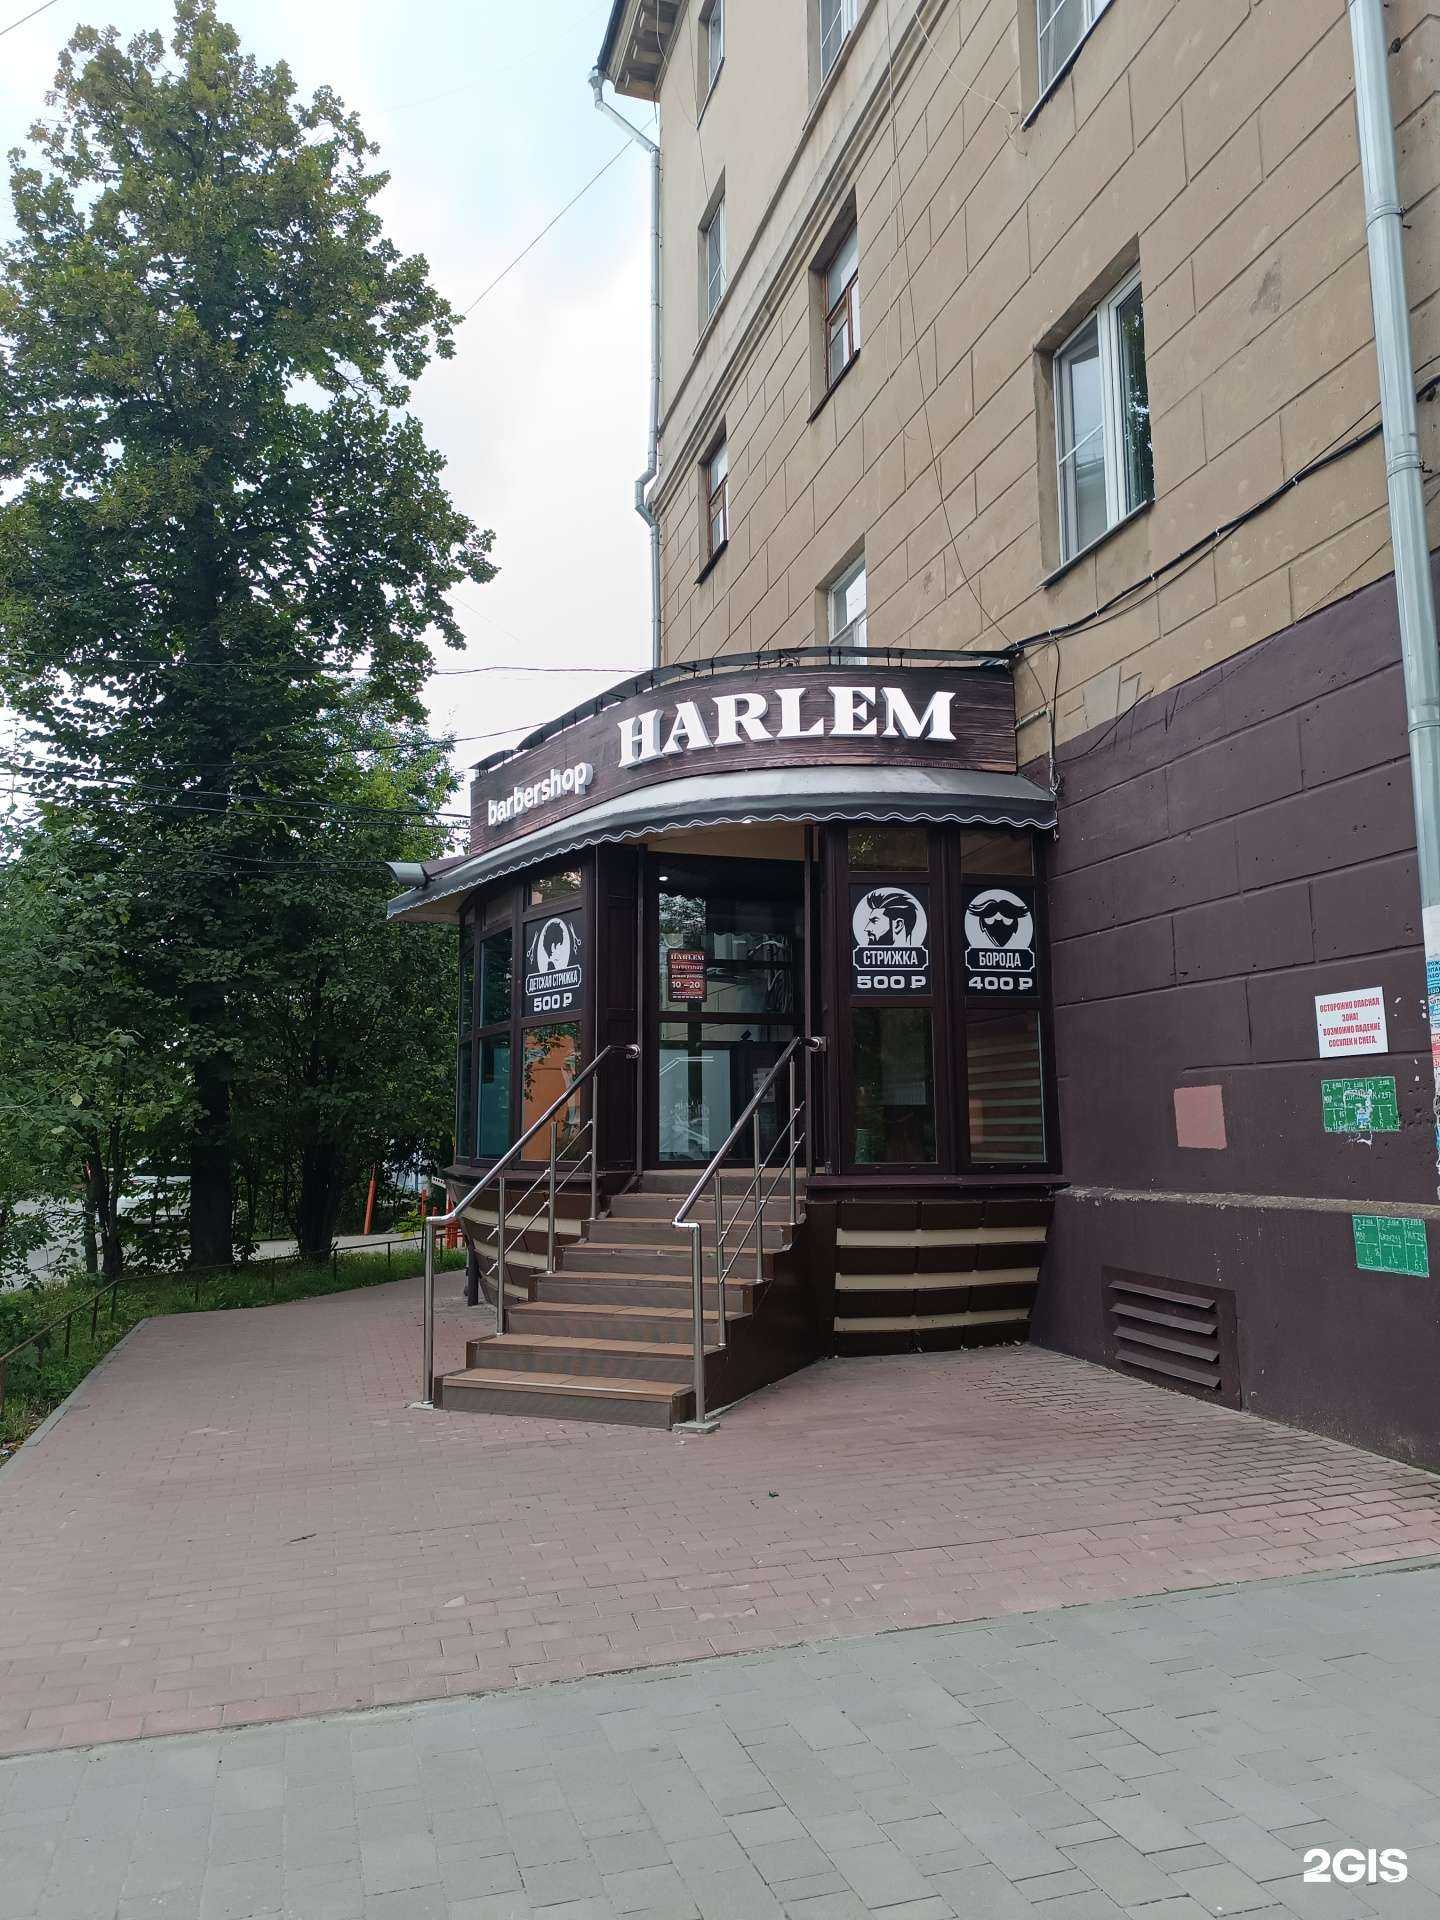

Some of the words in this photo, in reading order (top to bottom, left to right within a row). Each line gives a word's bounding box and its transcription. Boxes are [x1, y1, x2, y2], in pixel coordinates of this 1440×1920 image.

[617, 686, 957, 770] HARLEM
[487, 762, 594, 827] barbershop
[863, 951, 919, 965] СТРИЖКА
[979, 952, 1022, 968] БОРОДА
[529, 974, 552, 993] ДЕТСКАЯ
[552, 970, 578, 987] СТРИЖКА
[671, 981, 682, 989] 10
[856, 975, 906, 989] 500
[968, 976, 1014, 990] 400
[533, 994, 561, 1012] 500
[1320, 1000, 1353, 1013] ОСТОРОЖНО
[1353, 997, 1380, 1009] ОПАСНАЯ
[1323, 1024, 1355, 1036] ВОЗМОЖНО
[1355, 1022, 1381, 1034] ПАДЕНИЕ
